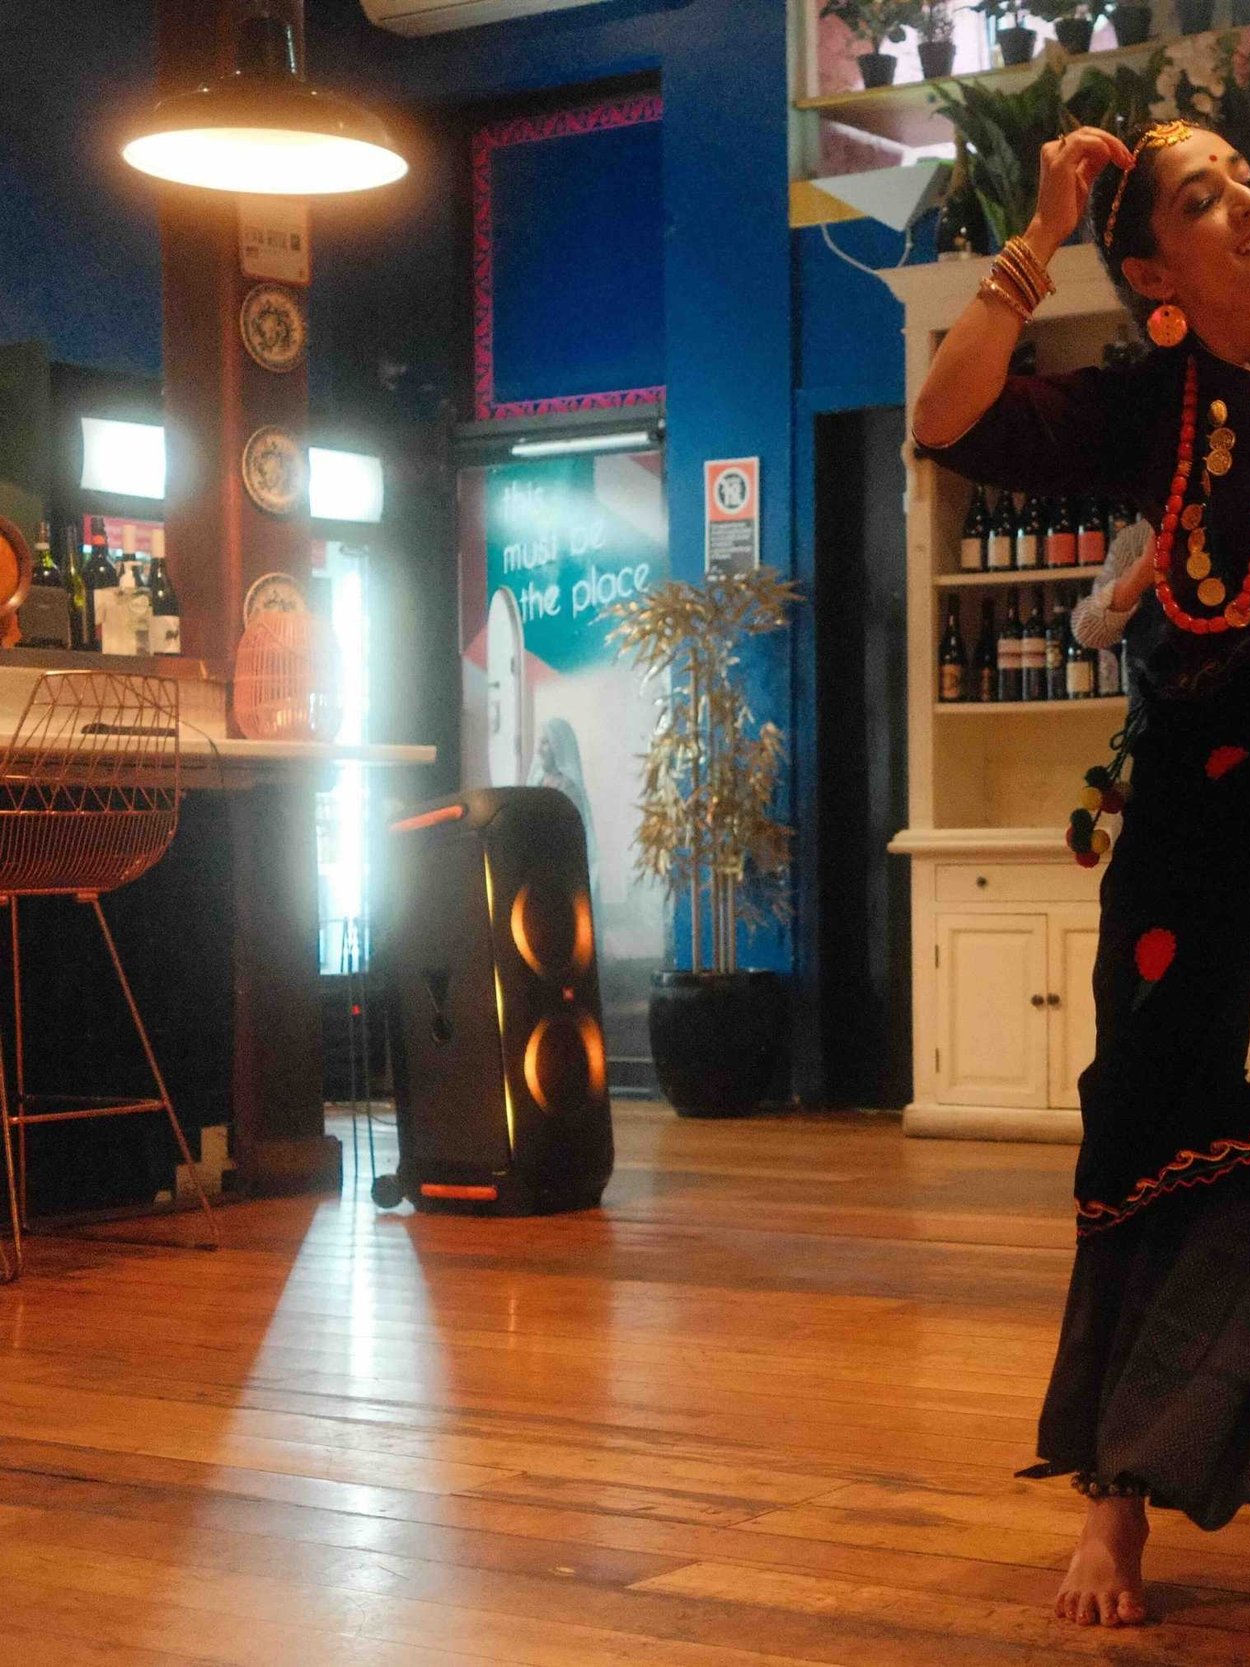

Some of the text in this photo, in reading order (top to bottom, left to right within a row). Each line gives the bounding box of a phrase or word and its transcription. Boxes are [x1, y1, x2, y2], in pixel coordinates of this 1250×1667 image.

[503, 527, 557, 574] must
[519, 563, 649, 624] the place
